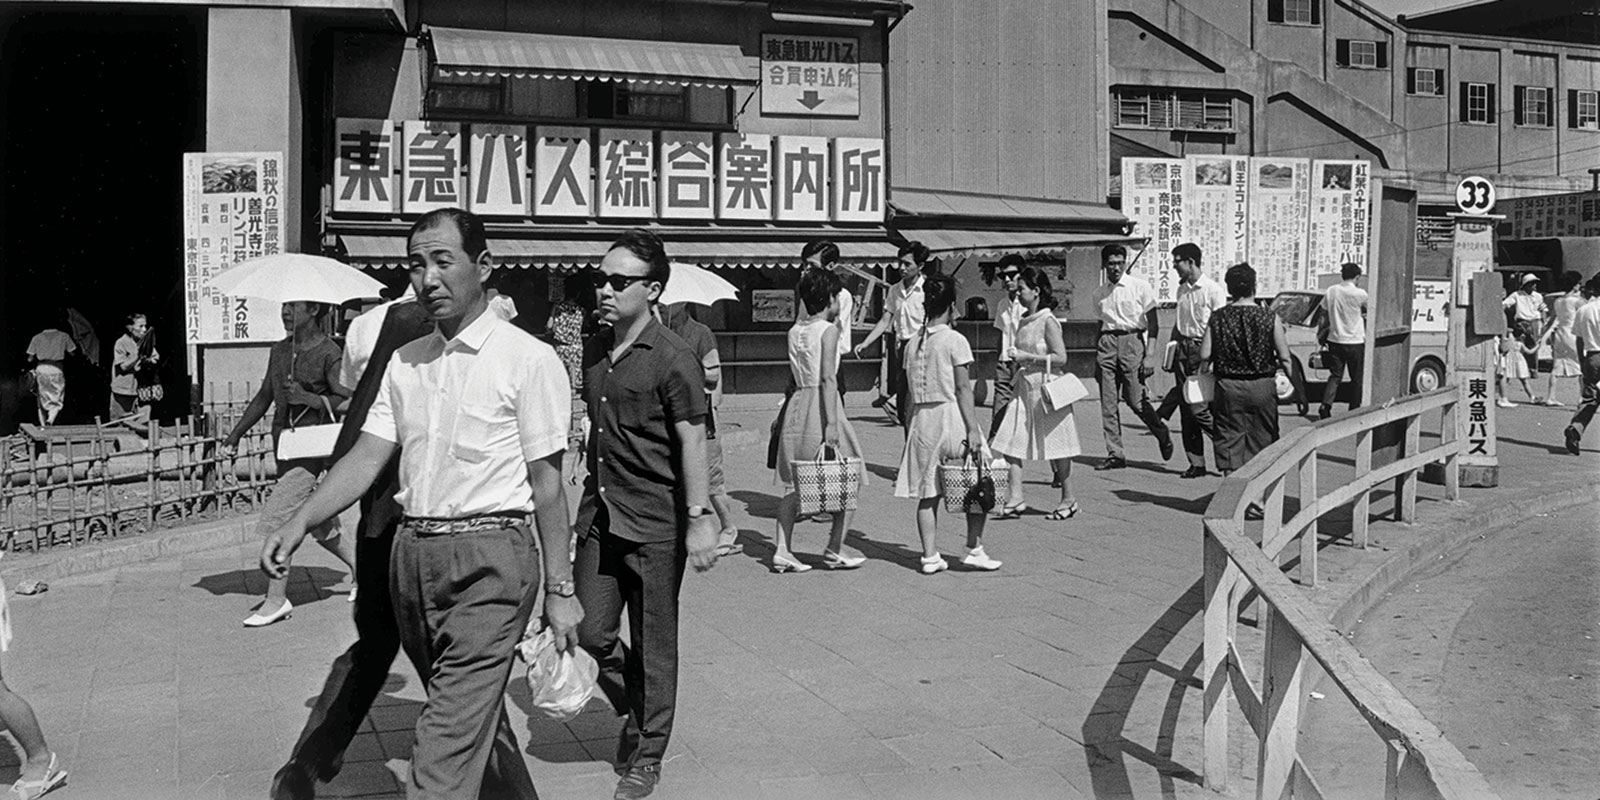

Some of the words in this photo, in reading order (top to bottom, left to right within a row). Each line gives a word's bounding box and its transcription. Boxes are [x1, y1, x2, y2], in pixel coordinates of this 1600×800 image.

[766, 38, 856, 63] 東急観光バス
[769, 65, 853, 88] 会員申込所
[340, 129, 881, 211] 東急バス綜合案内所
[1461, 180, 1490, 209] 33
[1468, 378, 1487, 455] 東急バス
